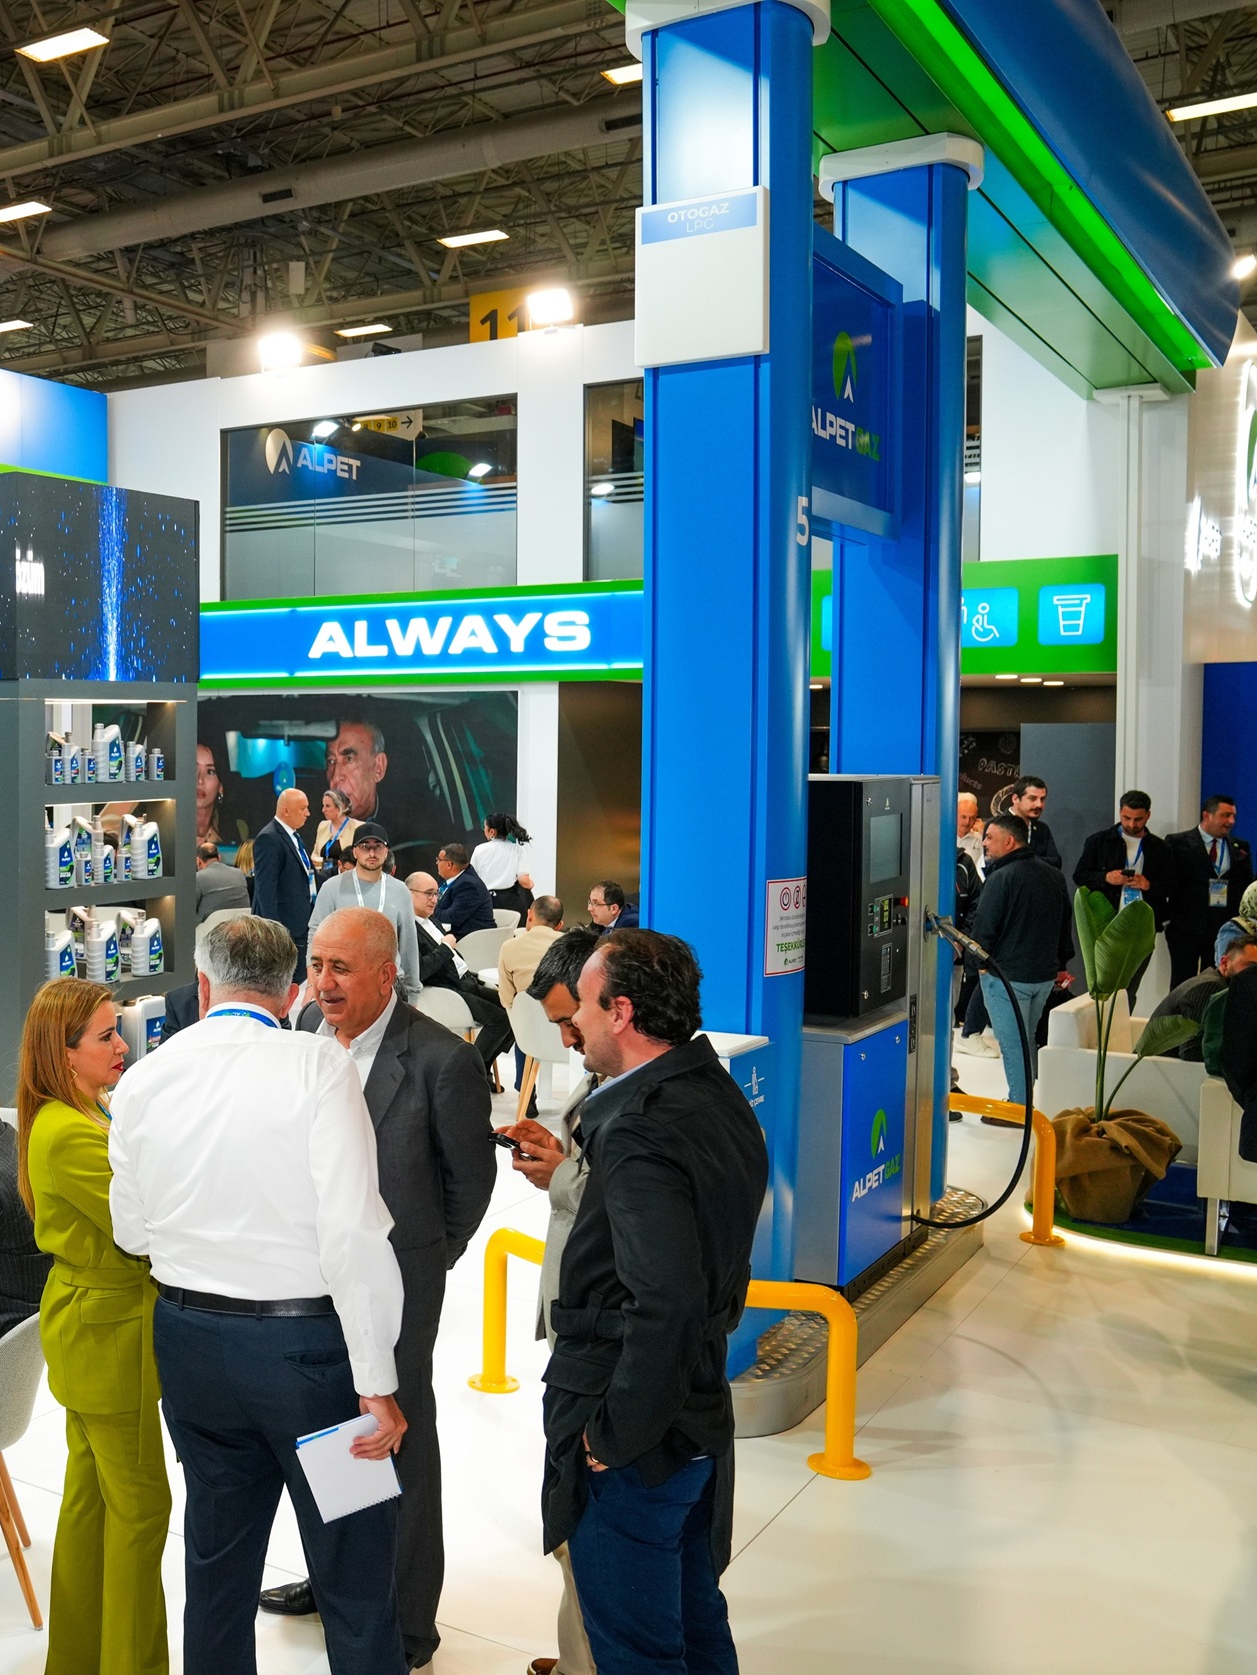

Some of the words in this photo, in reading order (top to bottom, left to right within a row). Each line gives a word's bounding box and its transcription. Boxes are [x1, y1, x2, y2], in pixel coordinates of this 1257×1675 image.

[667, 202, 730, 223] OTOGAZ
[686, 218, 714, 233] LPG
[388, 420, 397, 429] 10
[296, 446, 361, 481] ALPET
[796, 495, 810, 547] 5
[307, 610, 592, 659] ALWAYS
